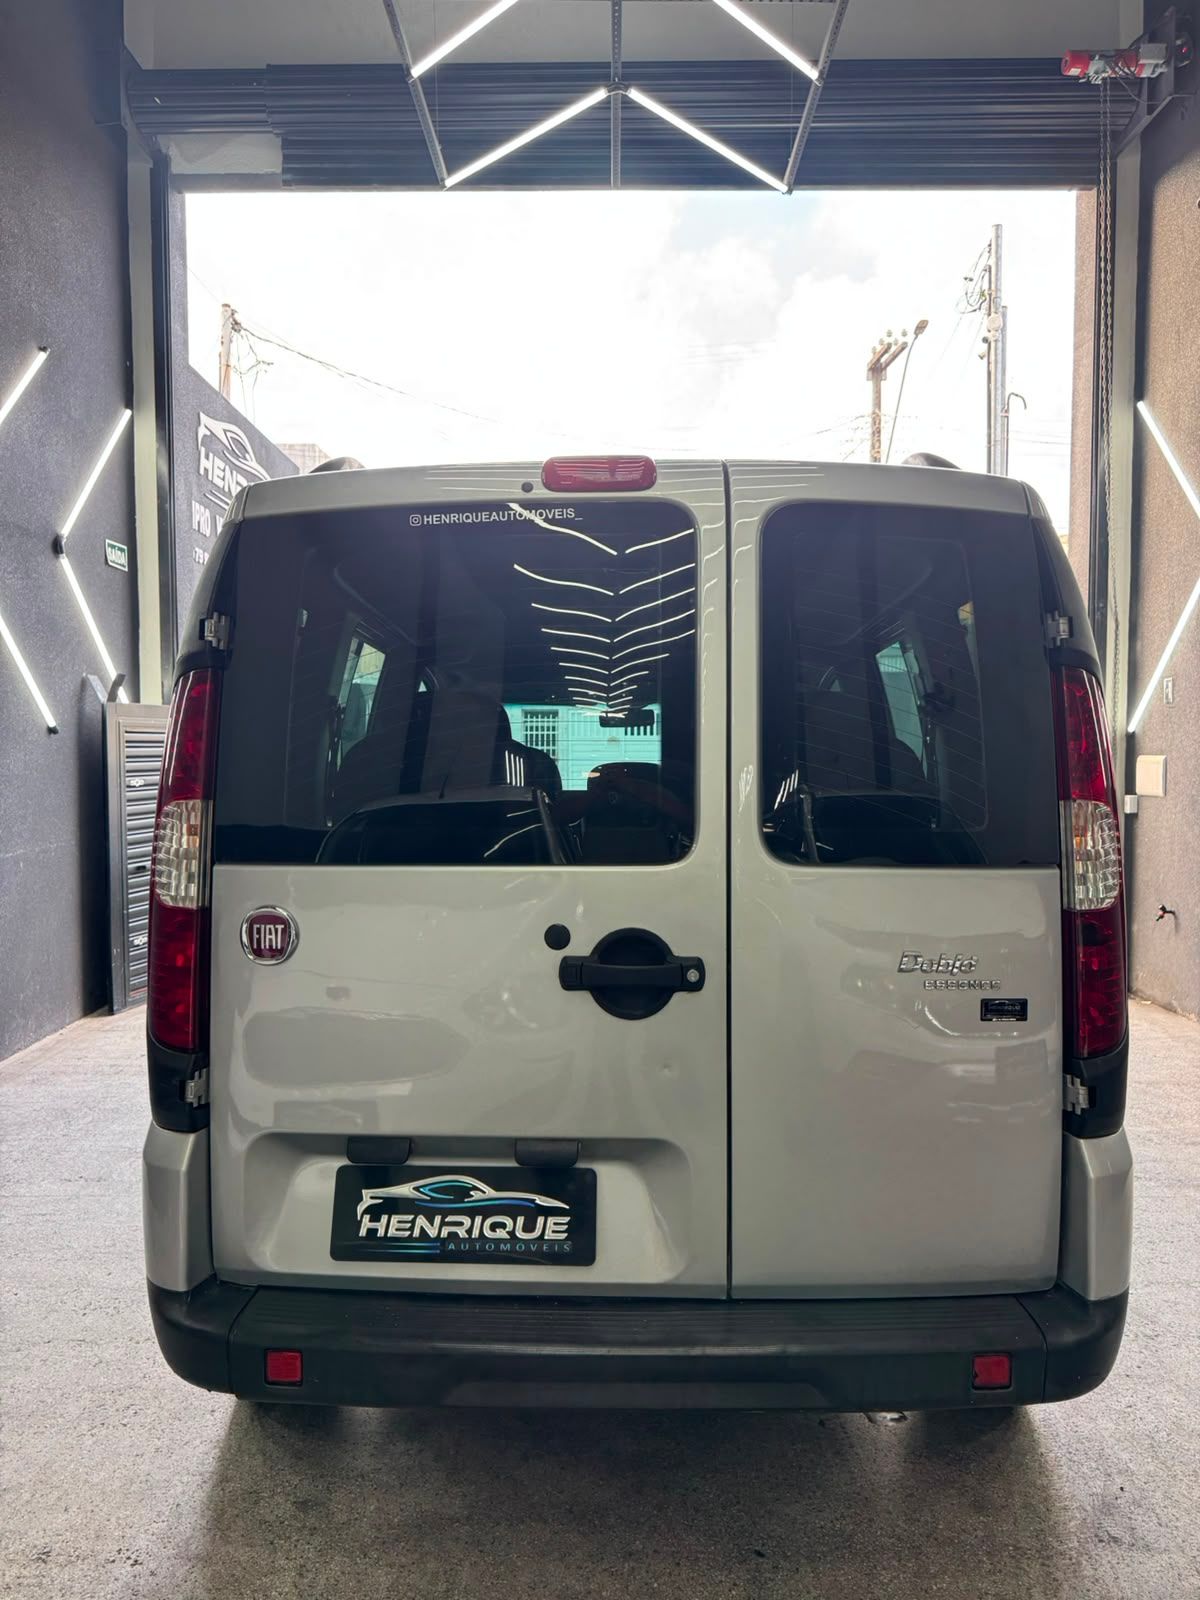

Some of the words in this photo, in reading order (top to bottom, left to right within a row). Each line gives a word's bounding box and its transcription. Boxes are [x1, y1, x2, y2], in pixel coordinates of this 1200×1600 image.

[252, 924, 285, 950] FIAT
[924, 979, 1001, 991] ESSENCE
[358, 1214, 571, 1240] HENRIQUE
